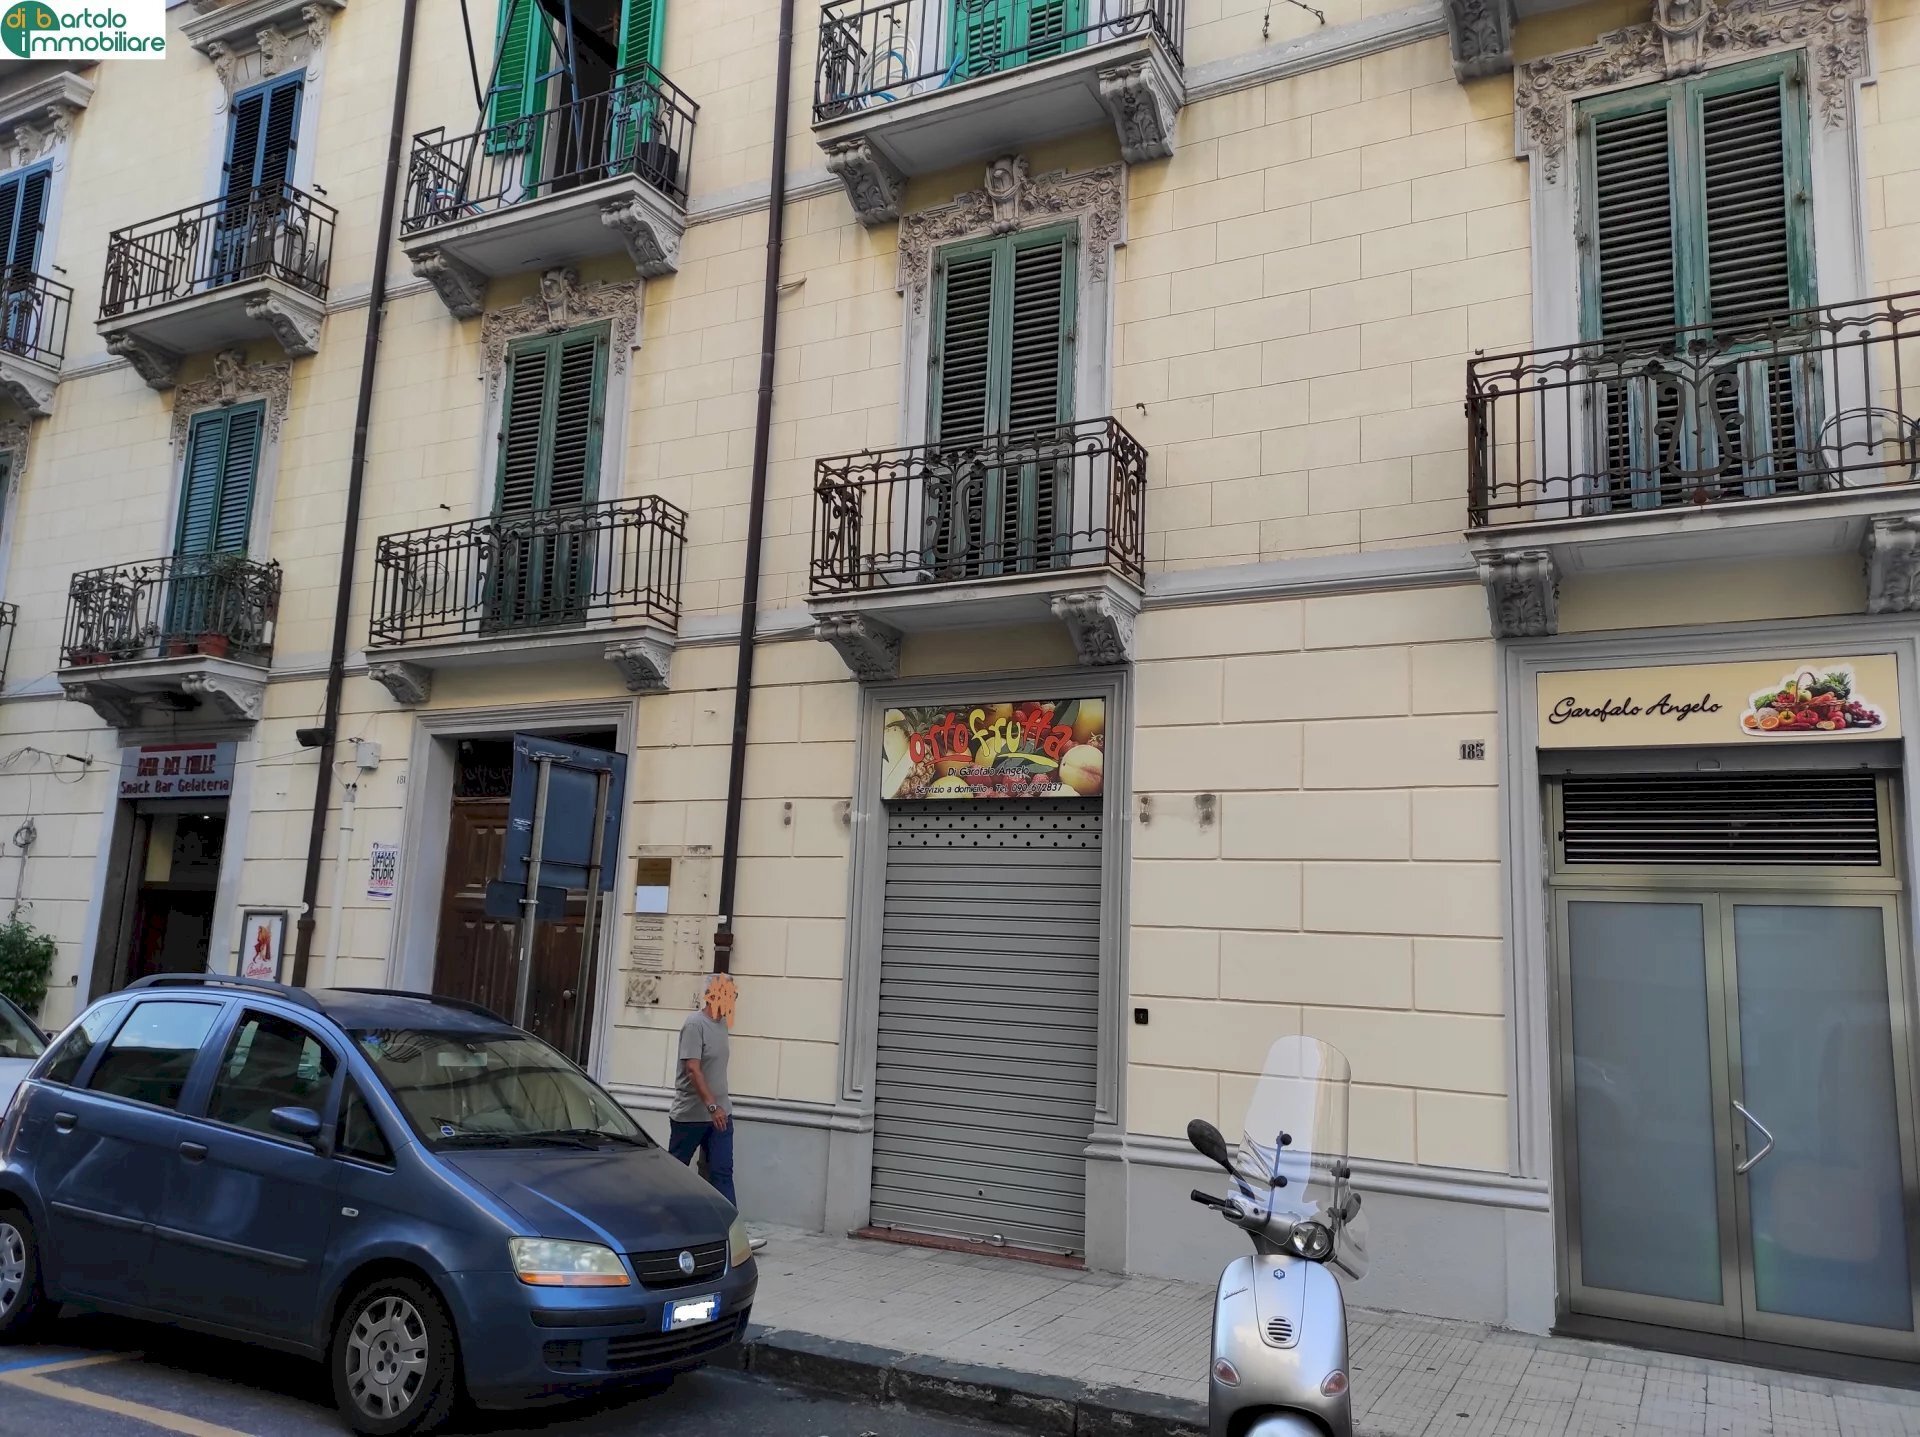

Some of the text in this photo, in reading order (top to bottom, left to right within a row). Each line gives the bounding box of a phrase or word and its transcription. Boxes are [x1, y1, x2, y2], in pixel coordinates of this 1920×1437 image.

[1549, 693, 1723, 725] Garofalo Angelo
[1460, 743, 1485, 760] 185
[947, 767, 957, 776] Di
[998, 765, 1030, 777] Angelo
[121, 778, 230, 795] Snack Bar Gelateria
[915, 785, 945, 794] Servizio
[954, 784, 988, 794] domicilio
[373, 857, 396, 868] UFFICIO
[370, 868, 395, 880] STUDIO
